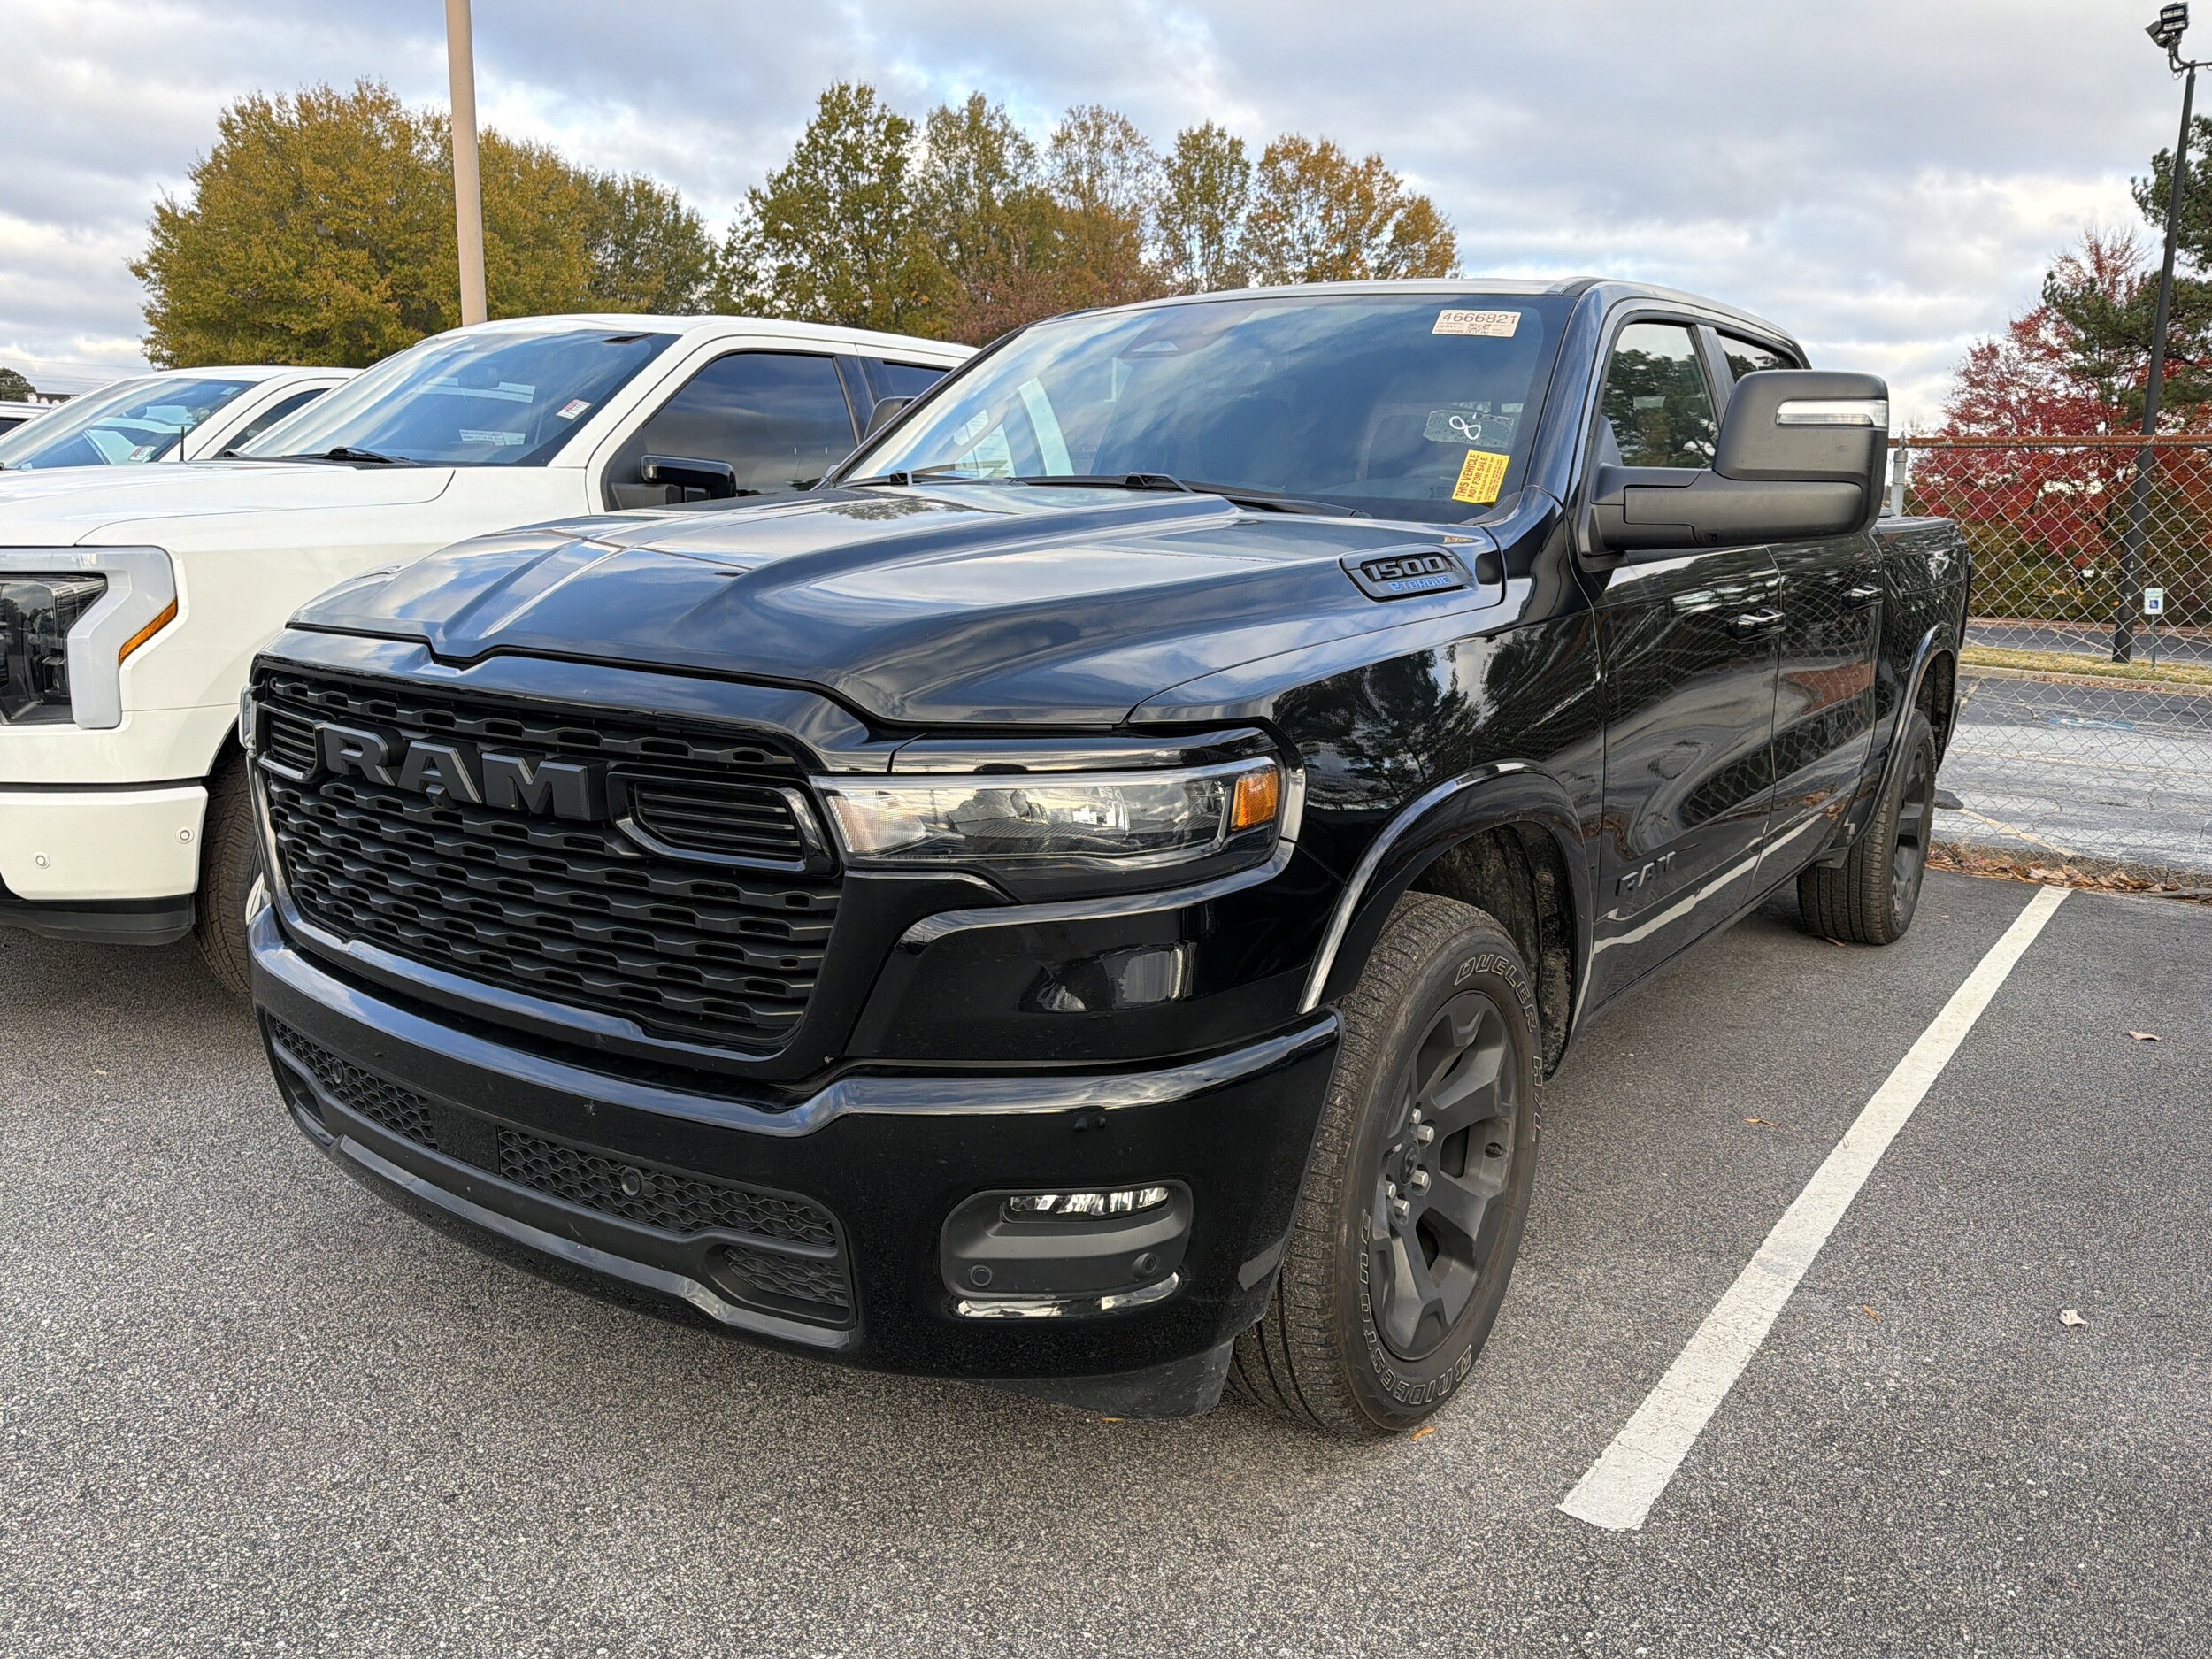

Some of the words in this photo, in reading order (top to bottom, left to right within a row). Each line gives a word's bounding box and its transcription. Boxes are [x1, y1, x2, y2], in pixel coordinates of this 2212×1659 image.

[1442, 312, 1517, 325] 4666821
[1448, 415, 1482, 440] 8
[1462, 453, 1479, 480] VEHICLE
[1477, 457, 1487, 472] SALE
[1455, 481, 1470, 497] THIS
[1472, 472, 1482, 485] FOR
[1467, 486, 1479, 498] NOT
[1363, 556, 1446, 580] 1500
[319, 721, 596, 821] RAM
[1455, 954, 1538, 1033] DUELER
[1359, 1209, 1472, 1405] BRIDGESTONE
